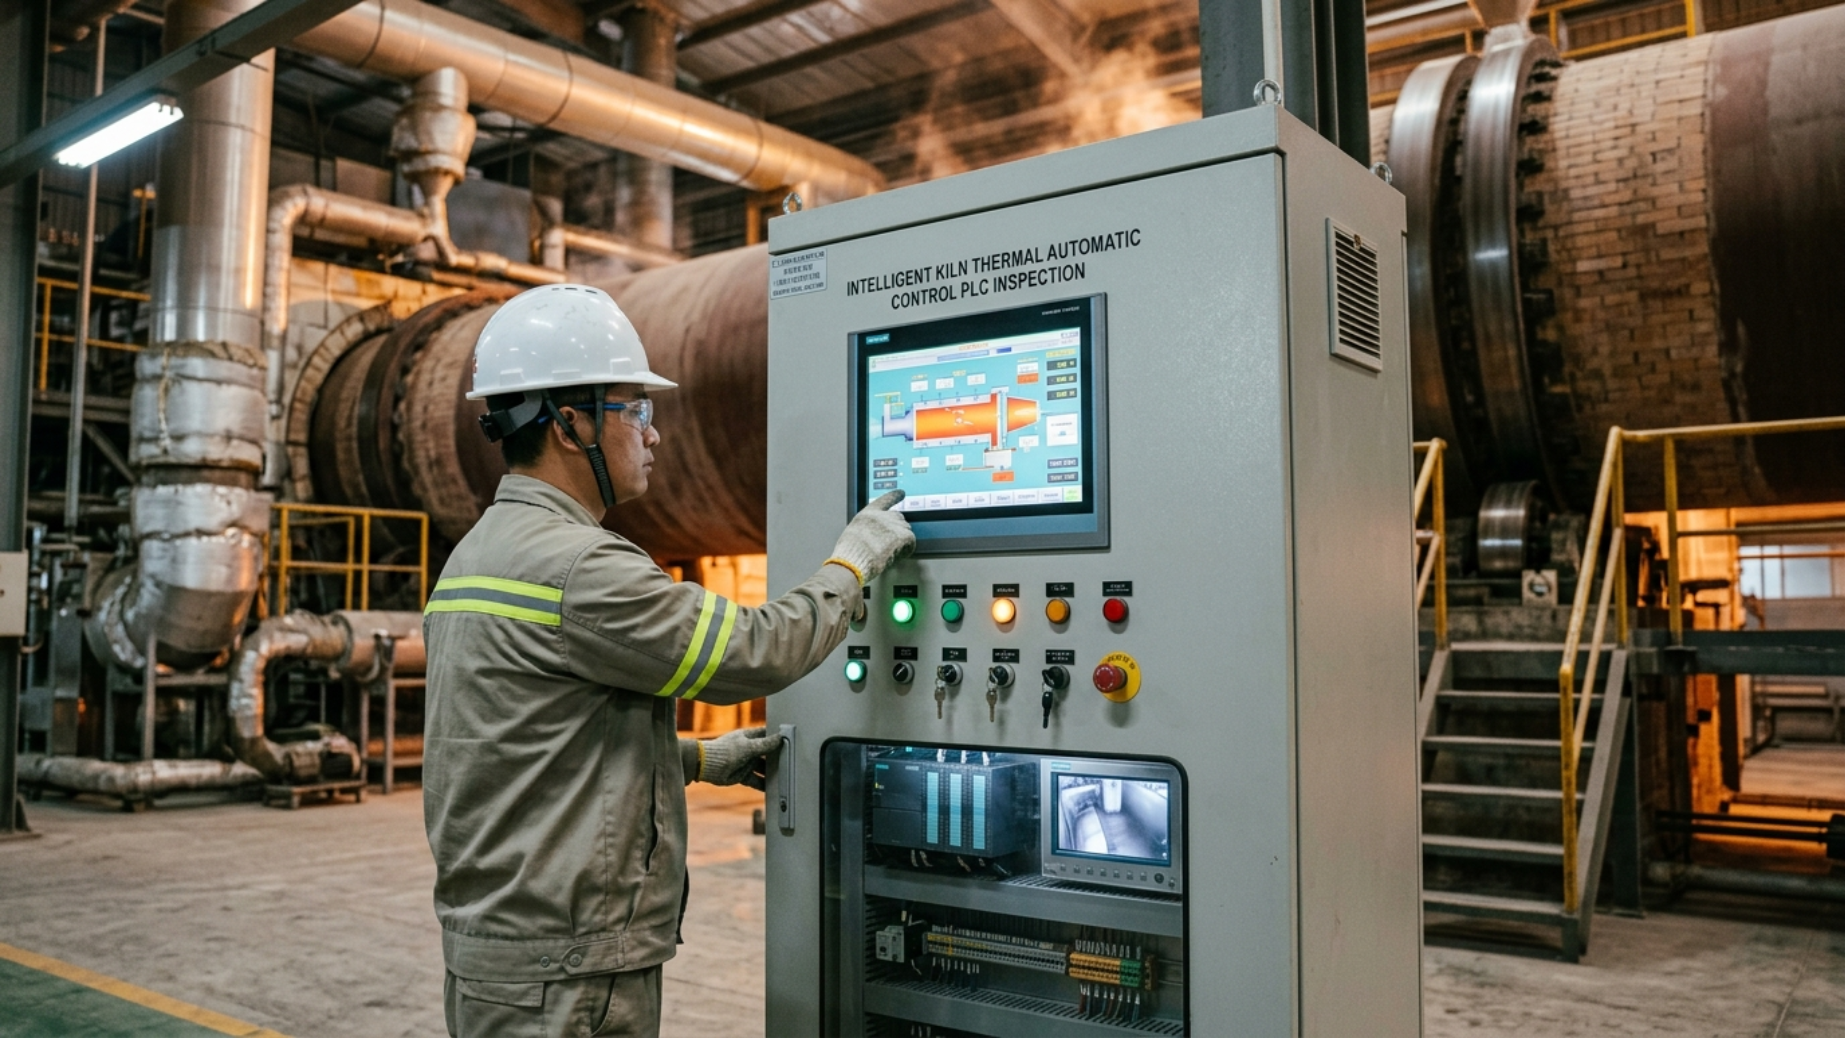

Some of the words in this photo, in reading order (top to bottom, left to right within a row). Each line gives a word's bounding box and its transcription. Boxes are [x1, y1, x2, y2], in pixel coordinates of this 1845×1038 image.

[847, 266, 933, 296] INTELLIGENT
[935, 260, 968, 281] KILN
[971, 247, 1044, 274] THERMAL
[1046, 228, 1141, 262] AUTOMATIC
[891, 285, 958, 310] CONTROL
[960, 278, 989, 299] PLC
[993, 262, 1085, 293] INSPECTION
